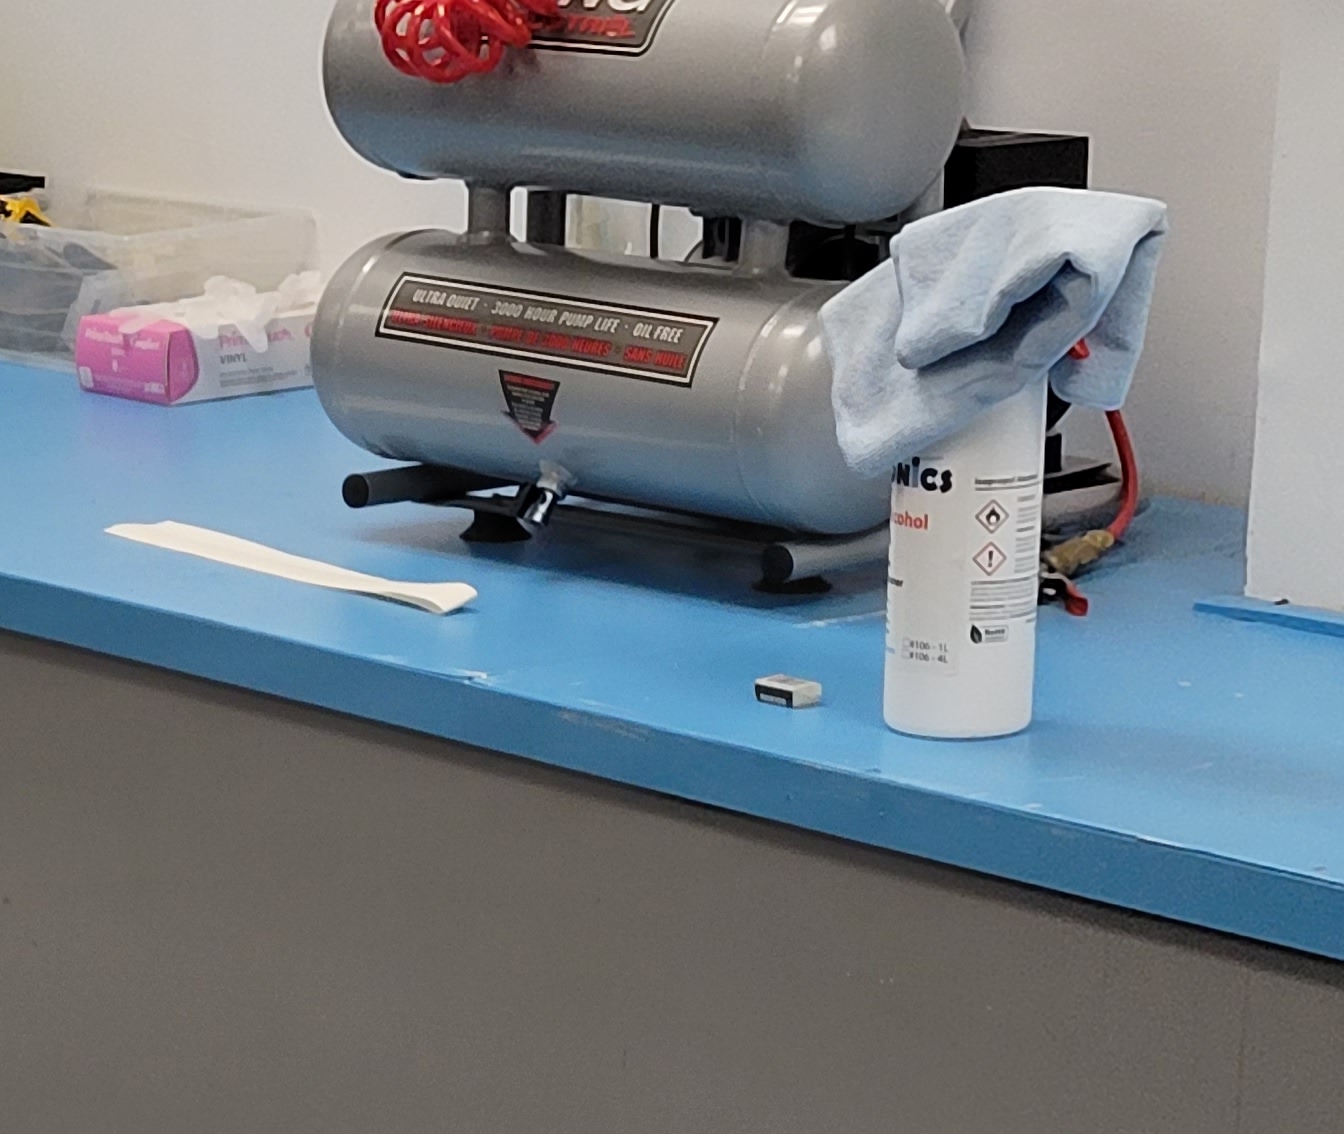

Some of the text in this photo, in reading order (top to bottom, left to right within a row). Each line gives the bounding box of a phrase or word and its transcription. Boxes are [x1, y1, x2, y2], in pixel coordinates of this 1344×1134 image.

[412, 288, 447, 306] ULTRA
[446, 293, 480, 311] QUIET
[491, 301, 524, 318] 3000
[524, 306, 558, 323] HOUR
[558, 311, 594, 328] PUMP
[594, 317, 620, 333] LIFE
[220, 353, 246, 364] VINYL
[572, 336, 612, 356] HEURES
[624, 345, 654, 363] SANS
[655, 351, 687, 370] HUILE
[892, 456, 952, 493] NiCS
